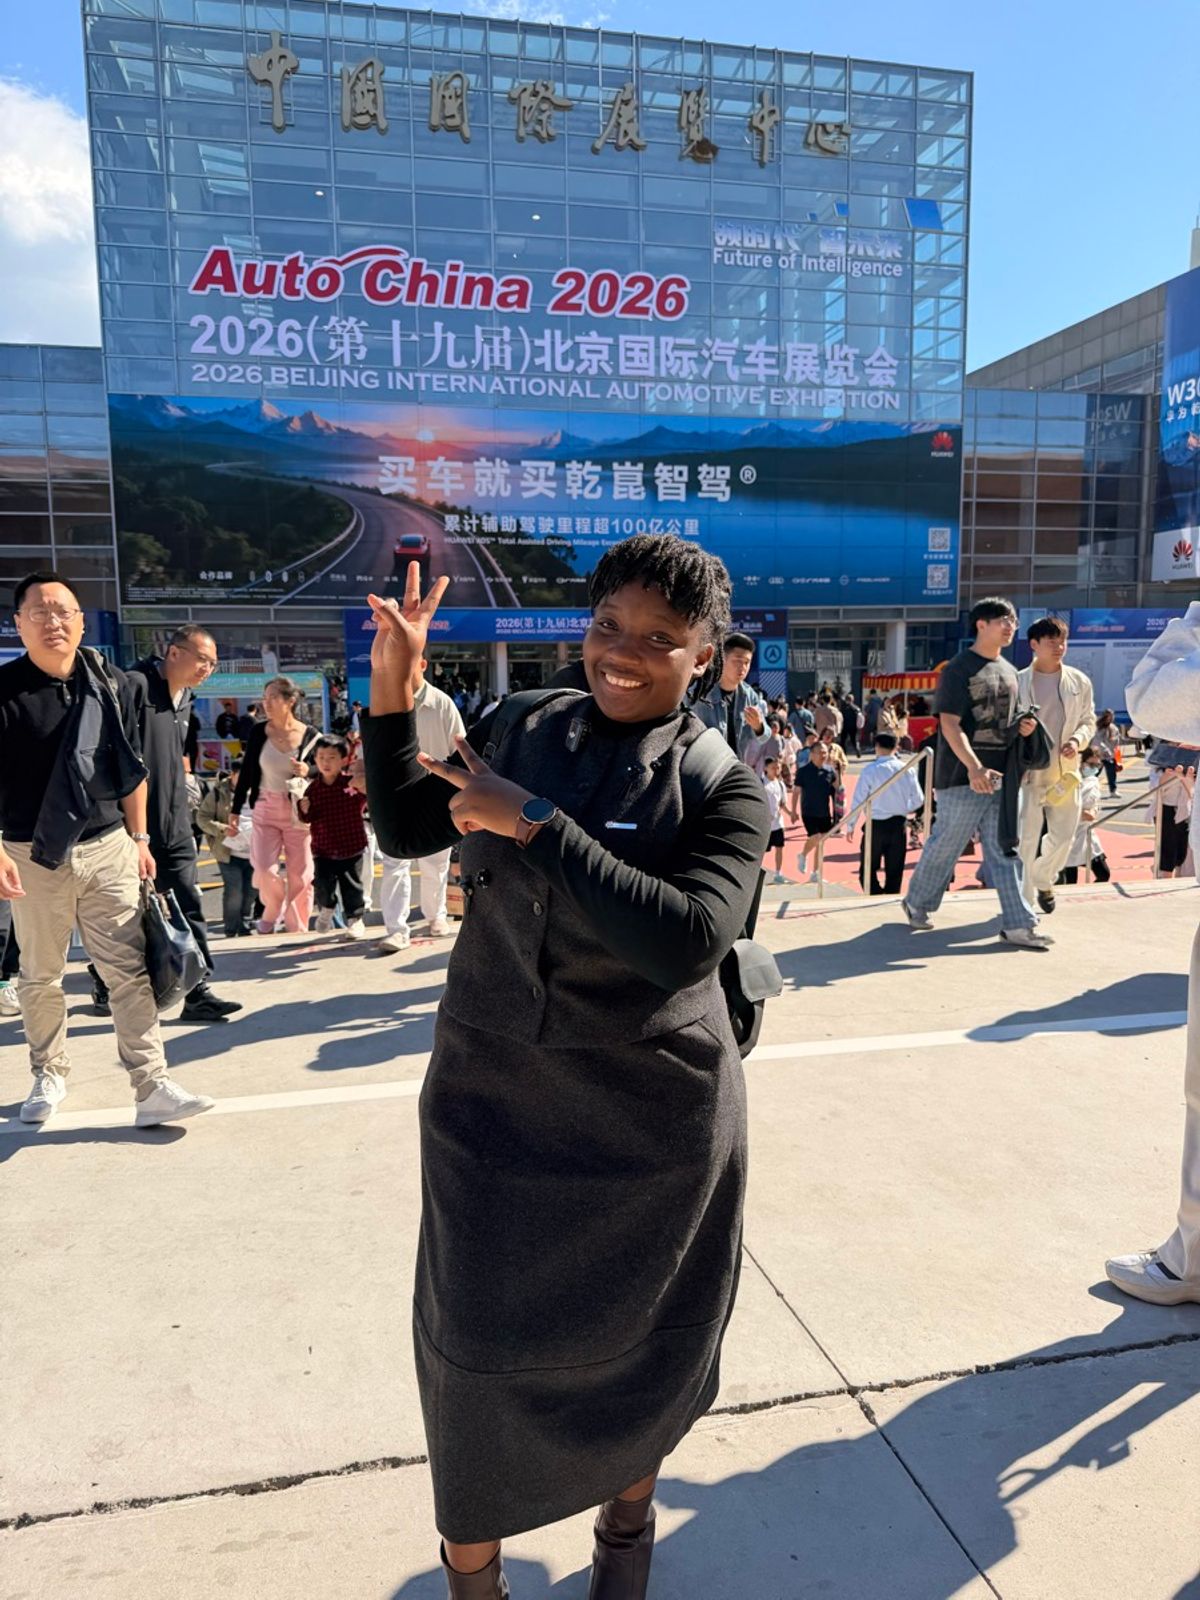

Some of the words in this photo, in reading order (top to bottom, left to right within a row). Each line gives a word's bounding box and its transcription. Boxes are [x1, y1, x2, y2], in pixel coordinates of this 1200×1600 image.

[188, 246, 343, 302] Auto
[362, 254, 533, 314] China
[547, 268, 692, 321] 2026
[713, 248, 773, 268] Future
[778, 252, 796, 269] of
[802, 256, 903, 278] Intelligence
[189, 314, 899, 388] 2026(第十九届)北京国际汽车展览会
[192, 364, 263, 384] 2026
[270, 367, 379, 389] BEIJING
[387, 371, 600, 398] INTERNATIONAL
[606, 381, 763, 404] AUTOMOTIVE
[770, 388, 900, 409] EXHIBITION
[444, 514, 700, 536] 累计辅助驾驶里程超100亿公里
